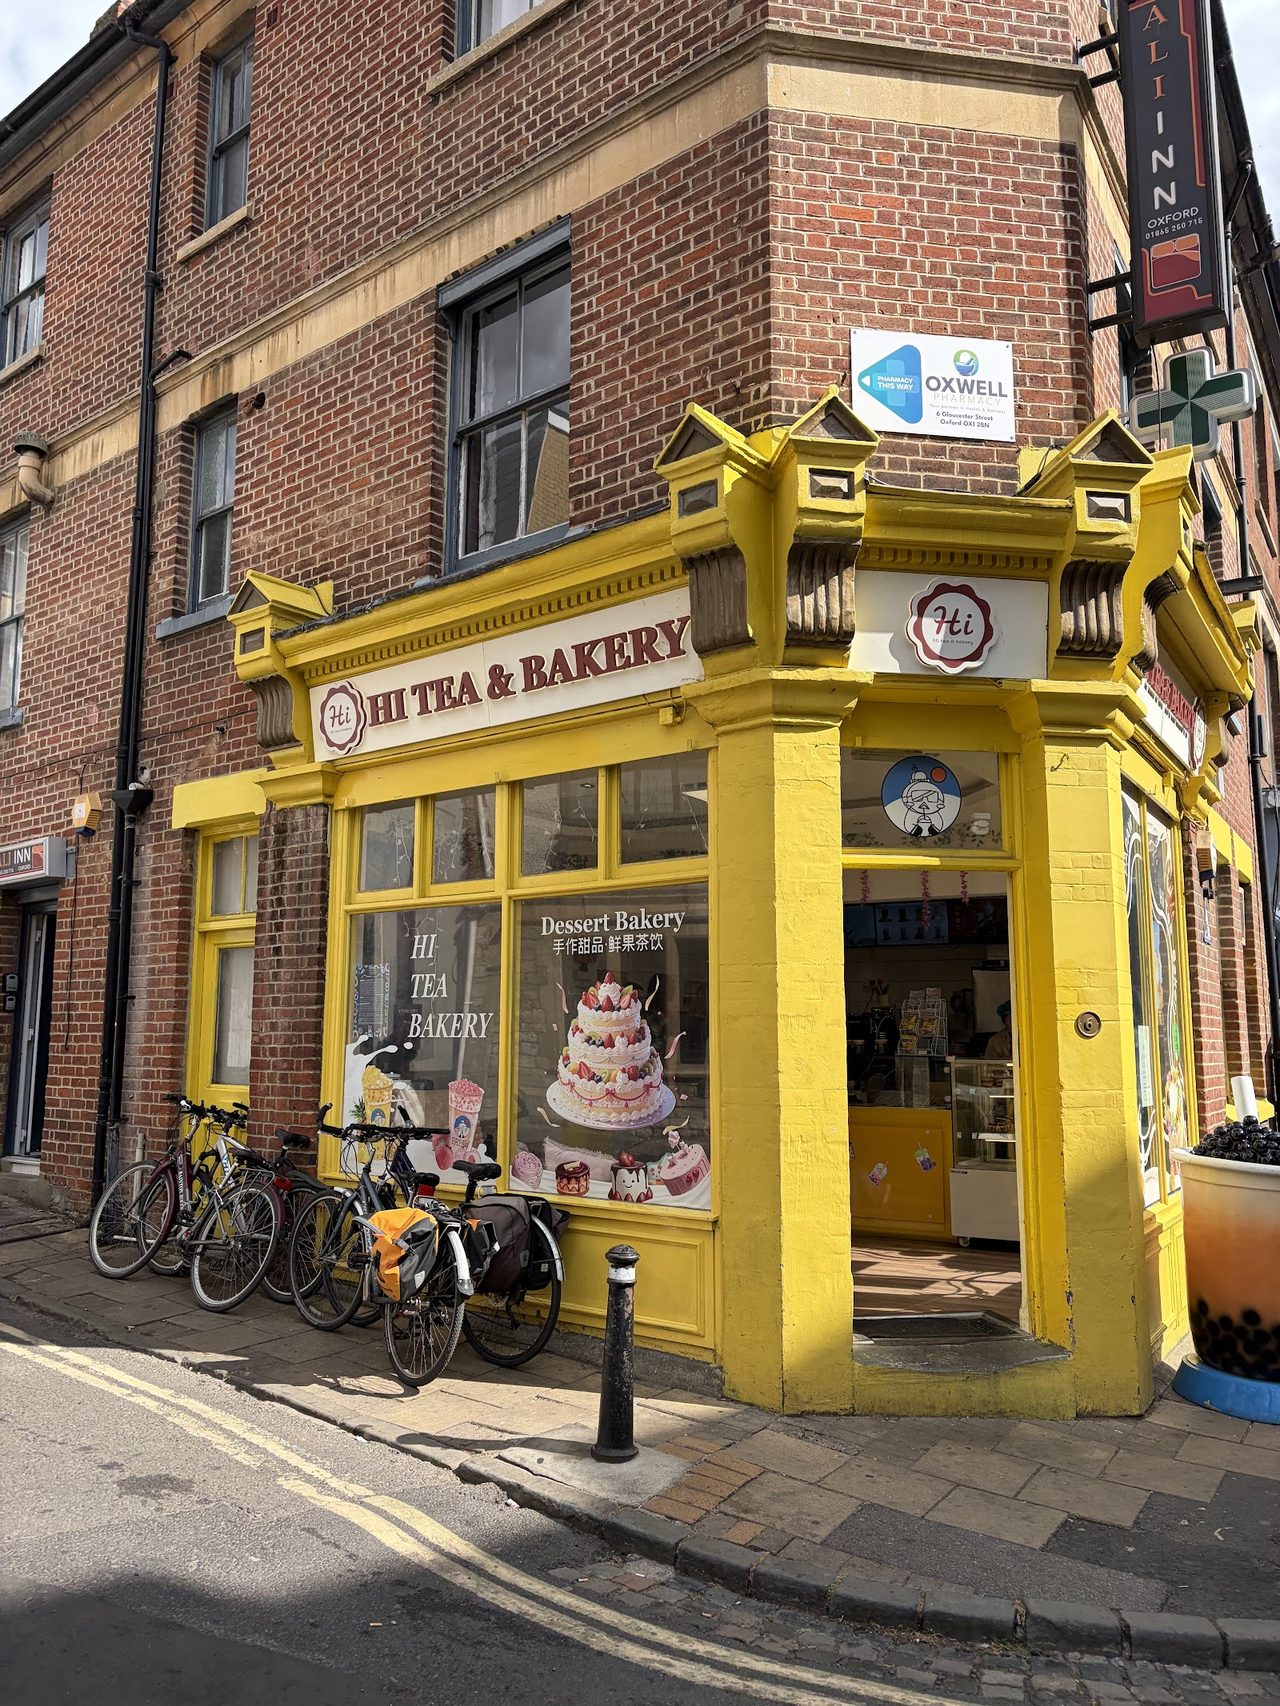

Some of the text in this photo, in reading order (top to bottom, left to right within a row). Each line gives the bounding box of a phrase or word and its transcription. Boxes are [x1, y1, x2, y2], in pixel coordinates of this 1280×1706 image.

[1152, 111, 1176, 210] INN
[1147, 207, 1199, 228] OXFORD
[1145, 226, 1170, 240] 01865
[1171, 222, 1186, 232] 250
[877, 375, 914, 384] PHARMACY
[877, 381, 914, 391] THIS WAY
[925, 375, 1008, 398] OXWELL
[933, 392, 1002, 406] PHARMACY
[940, 418, 962, 426] Oxford
[941, 411, 974, 419] Gloucester
[933, 605, 974, 636] Hi
[367, 615, 691, 727] HI TEA & BAKERY
[329, 704, 352, 728] Hi
[13, 846, 31, 865] INN
[540, 908, 686, 936] Dessert Bakery
[410, 934, 437, 959] HI
[410, 973, 448, 998] TEA
[407, 1012, 494, 1038] BAKERY
